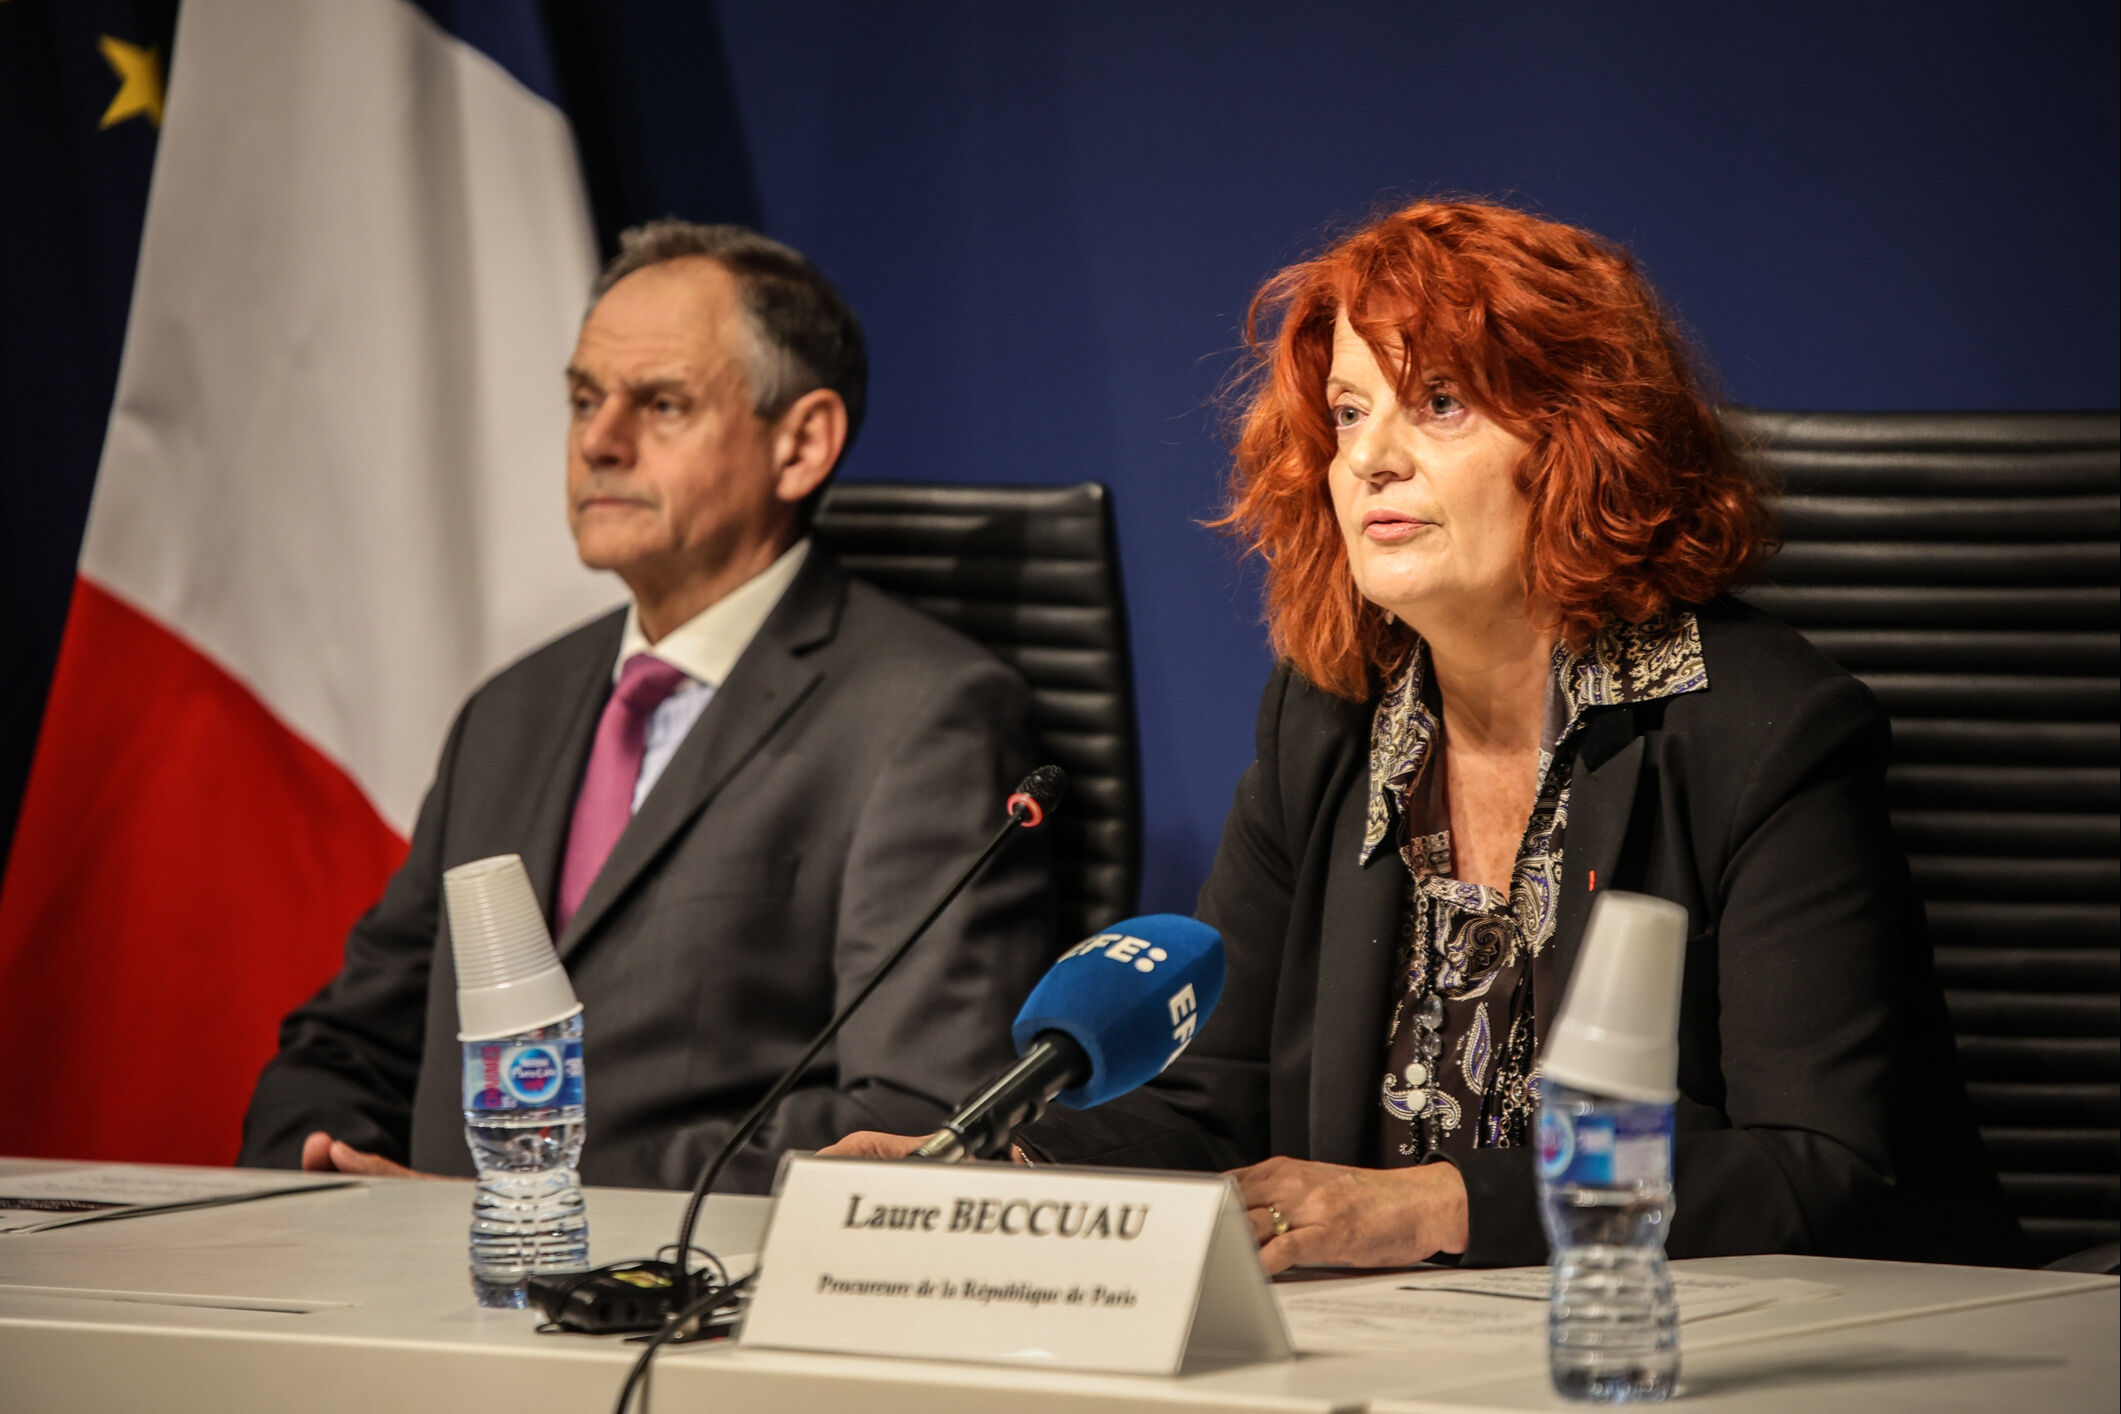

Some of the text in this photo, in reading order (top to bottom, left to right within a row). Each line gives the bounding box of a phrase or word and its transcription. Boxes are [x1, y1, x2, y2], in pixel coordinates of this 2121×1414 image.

[1057, 933, 1168, 973] FE:
[1162, 983, 1198, 1073] EF
[842, 1193, 1149, 1240] Laure BECCUAU
[817, 1273, 1137, 1309] Procureure de la République de Paris
